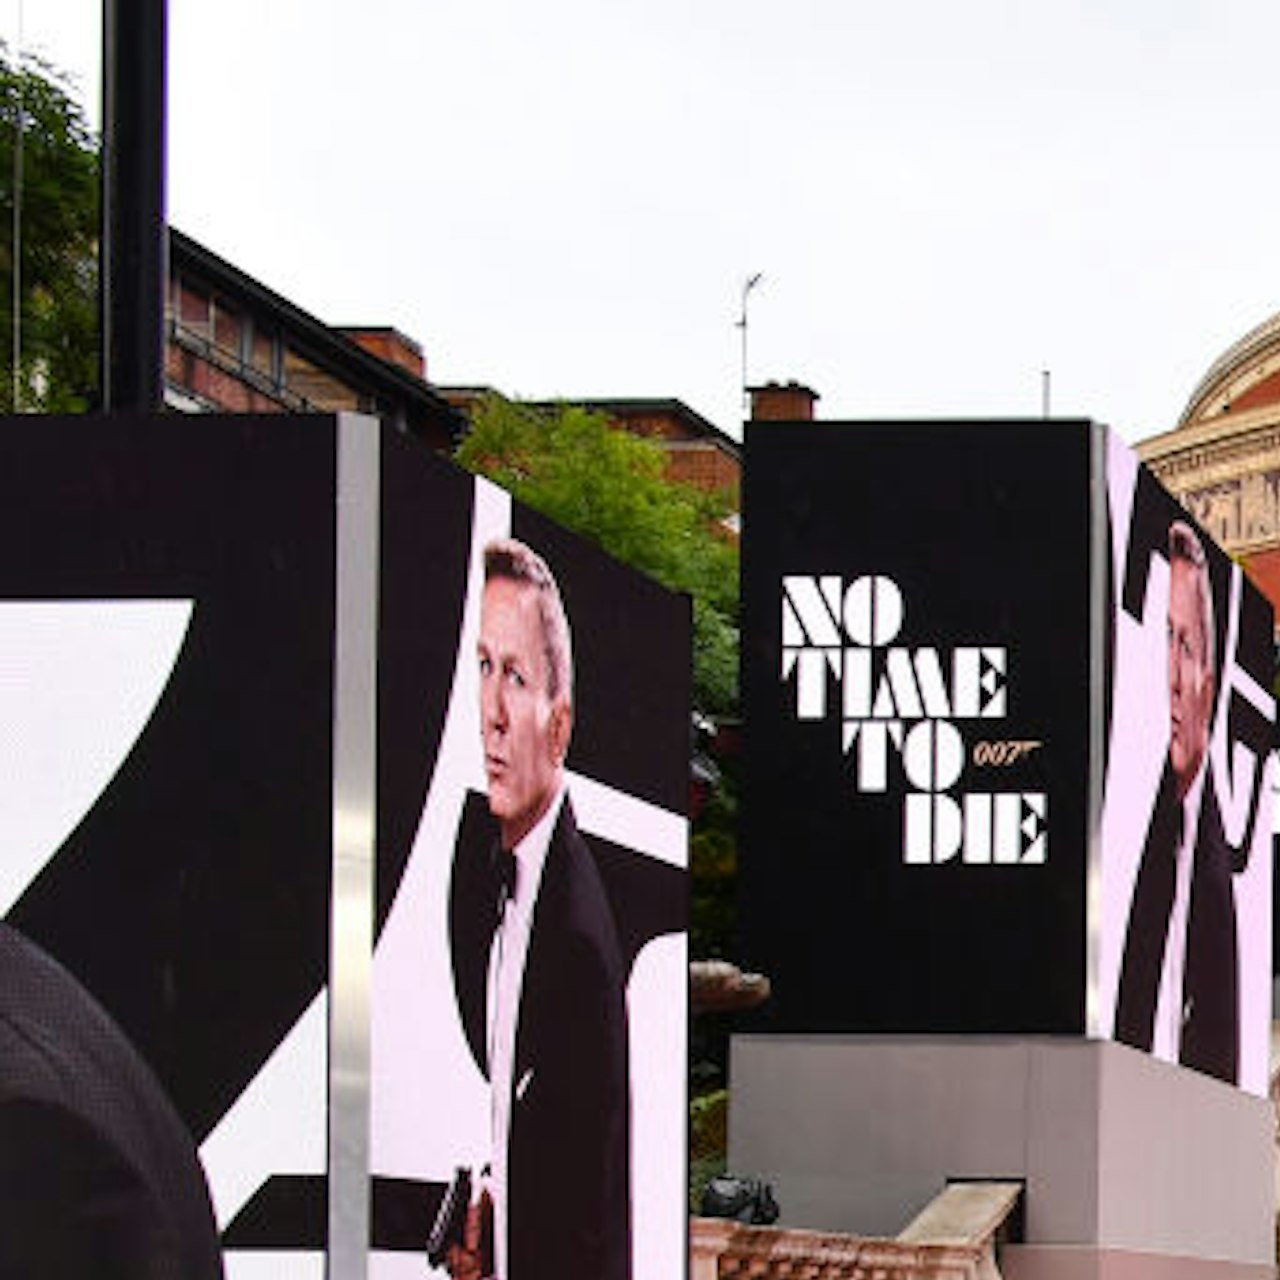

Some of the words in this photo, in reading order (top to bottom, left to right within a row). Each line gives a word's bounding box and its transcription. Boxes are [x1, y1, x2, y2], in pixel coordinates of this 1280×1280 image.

[781, 575, 903, 647] NO
[781, 646, 1007, 719] TIME
[842, 718, 965, 793] TO
[972, 739, 1043, 768] 007
[903, 792, 1048, 865] DIE
